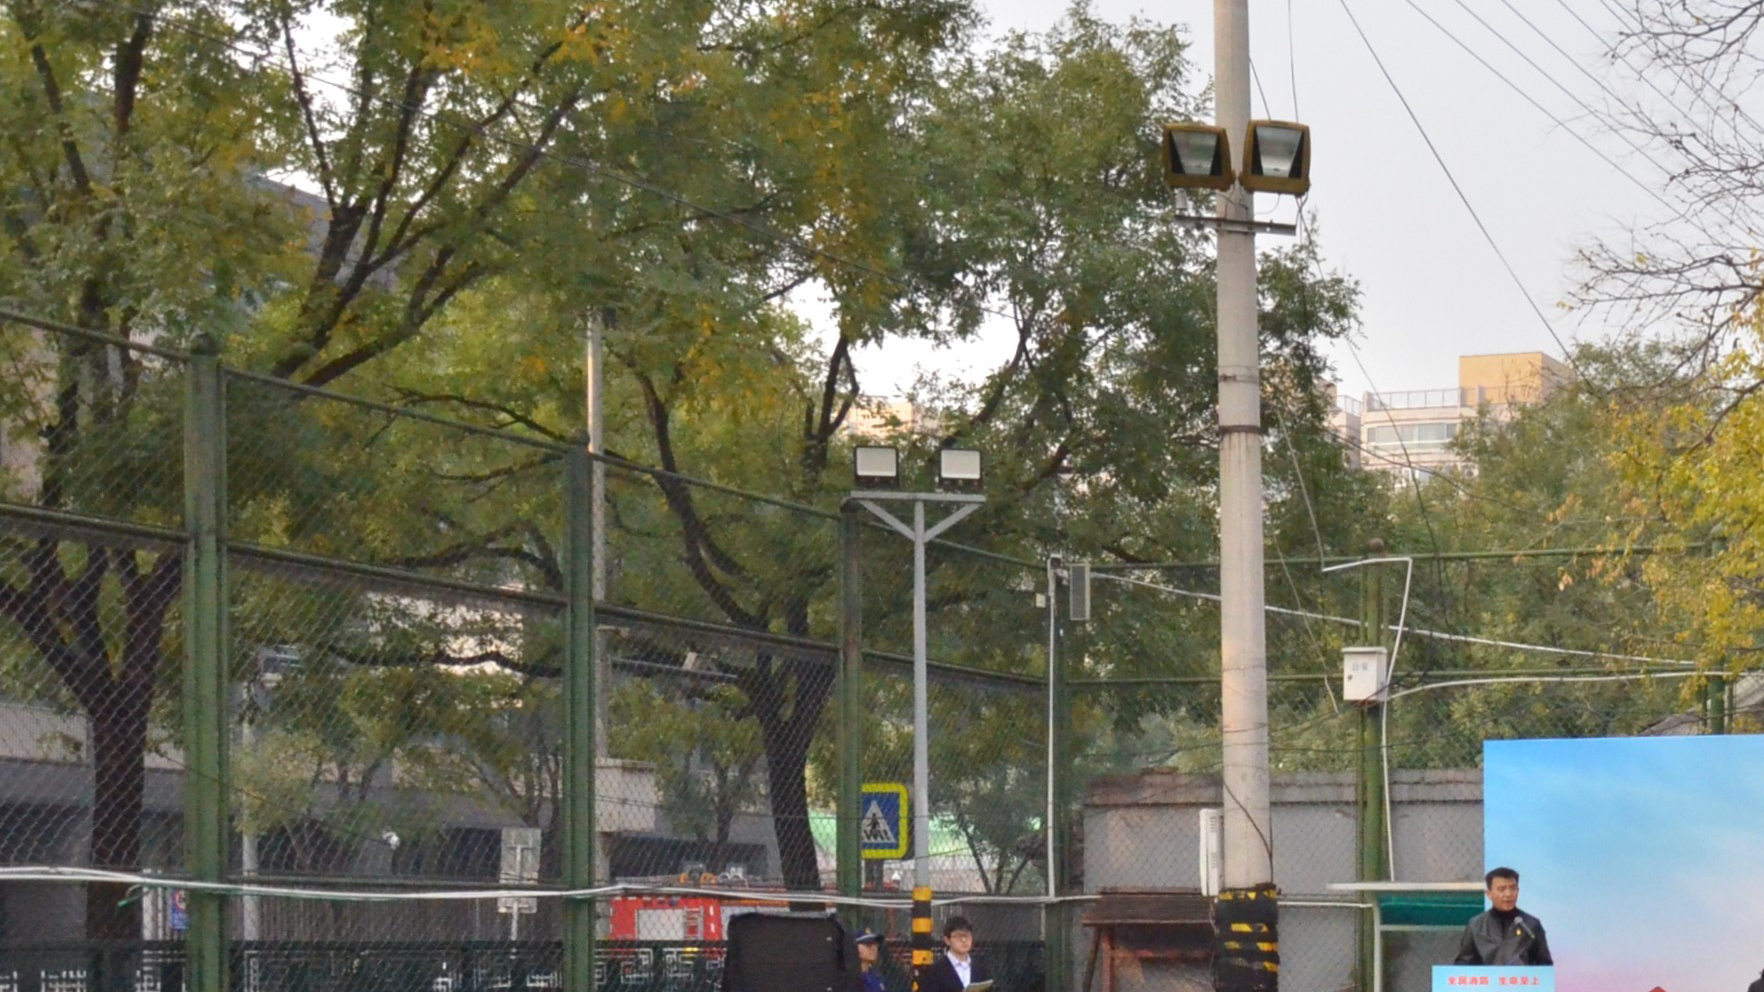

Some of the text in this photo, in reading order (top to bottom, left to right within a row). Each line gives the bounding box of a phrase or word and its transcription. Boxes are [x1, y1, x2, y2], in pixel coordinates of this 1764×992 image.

[1448, 976, 1540, 987] 全民消防 生命至上
